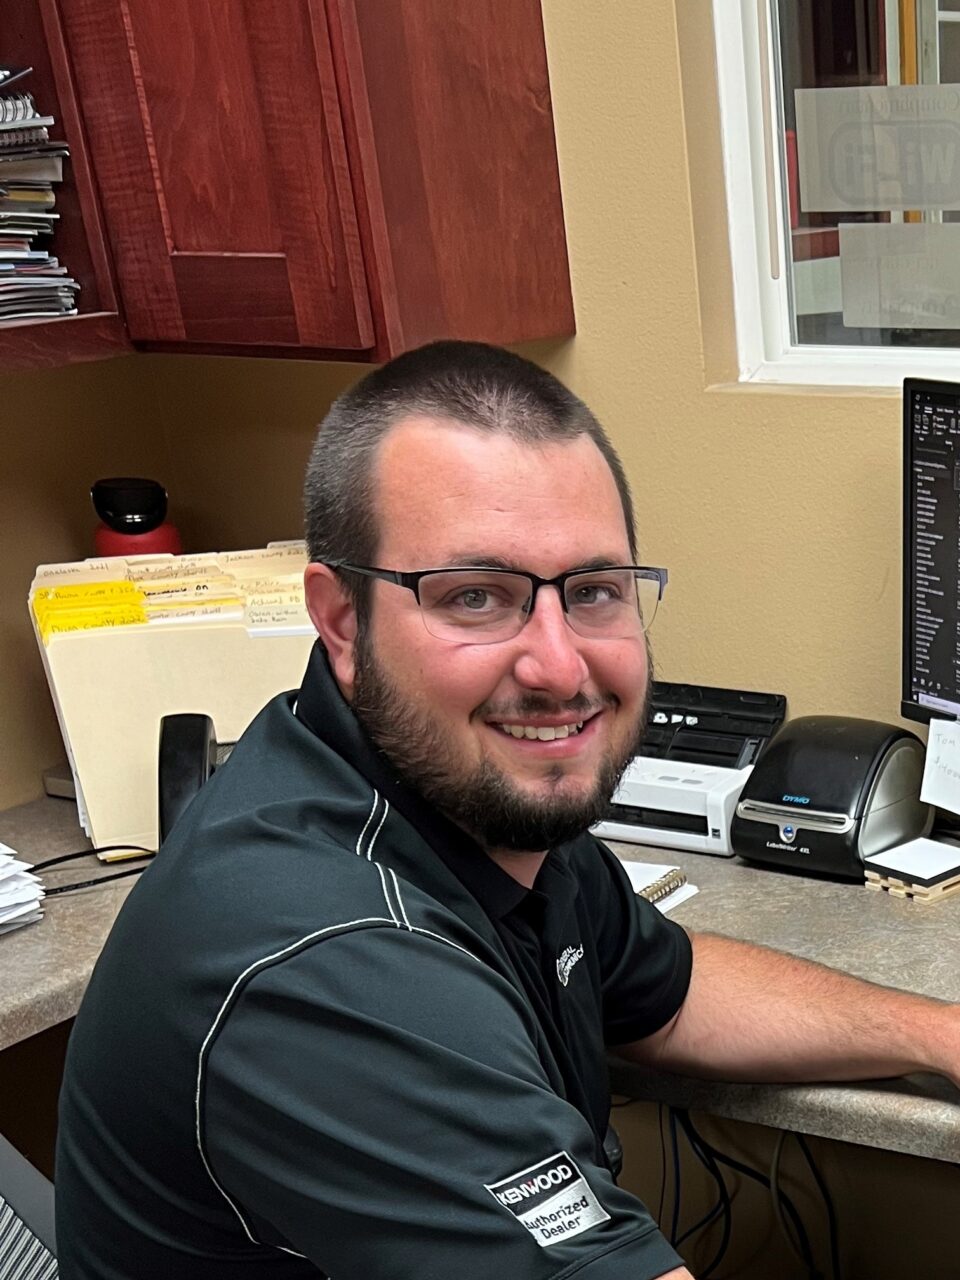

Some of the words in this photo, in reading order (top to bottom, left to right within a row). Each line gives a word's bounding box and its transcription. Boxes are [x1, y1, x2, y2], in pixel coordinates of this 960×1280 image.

[782, 795, 811, 804] DYMO
[496, 1164, 573, 1206] KENWOOD
[524, 1195, 590, 1230] Authorized
[540, 1215, 581, 1240] Dealer
